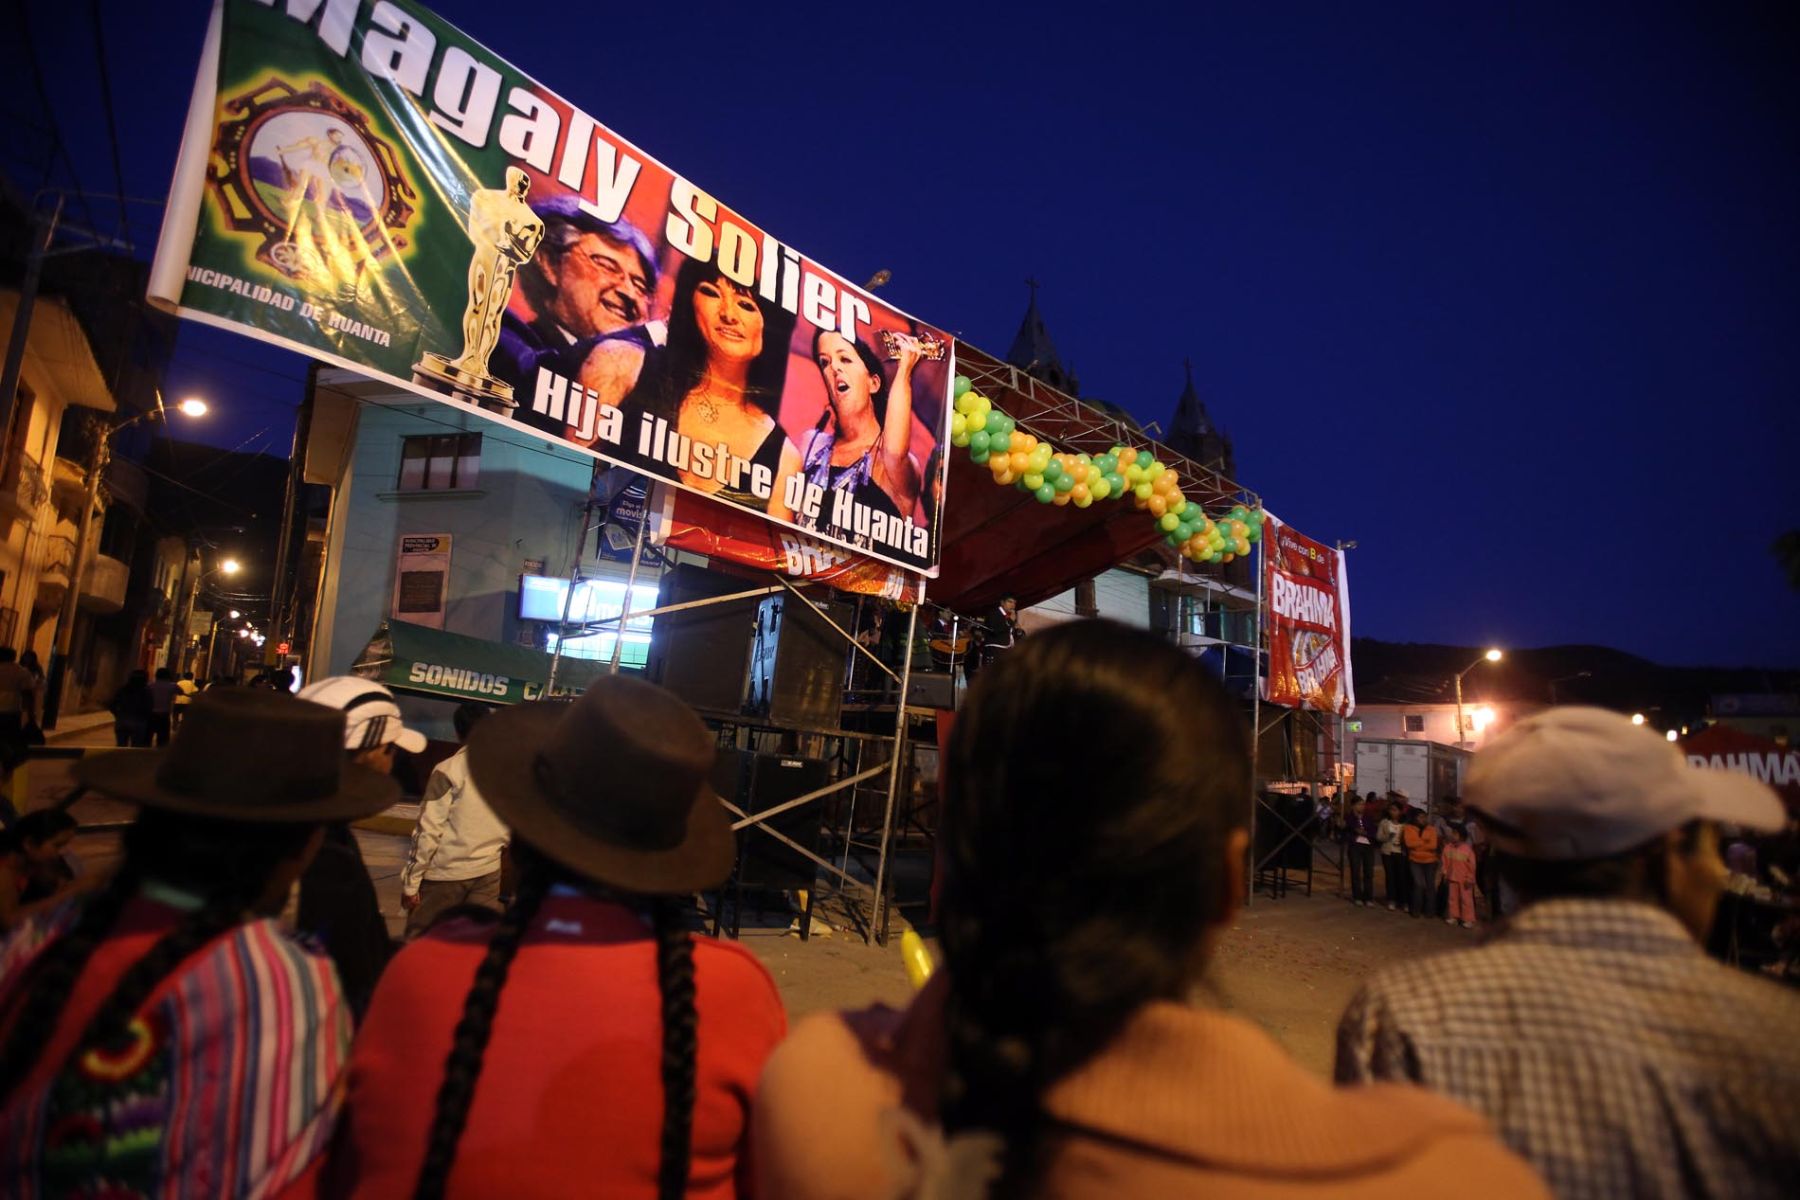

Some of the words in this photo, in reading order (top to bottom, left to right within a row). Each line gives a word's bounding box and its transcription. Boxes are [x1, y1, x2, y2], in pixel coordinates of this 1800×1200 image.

[665, 176, 871, 345] Solier
[186, 265, 295, 311] NICIPALIDAD
[299, 301, 324, 322] DE
[327, 312, 391, 347] HUANTA
[532, 366, 624, 446] Hija
[637, 412, 772, 500] ilustre
[782, 472, 822, 519] de
[832, 486, 930, 559] Huanta
[1309, 547, 1316, 560] B
[1272, 572, 1335, 631] BRAHMA
[409, 661, 510, 696] SONIDOS
